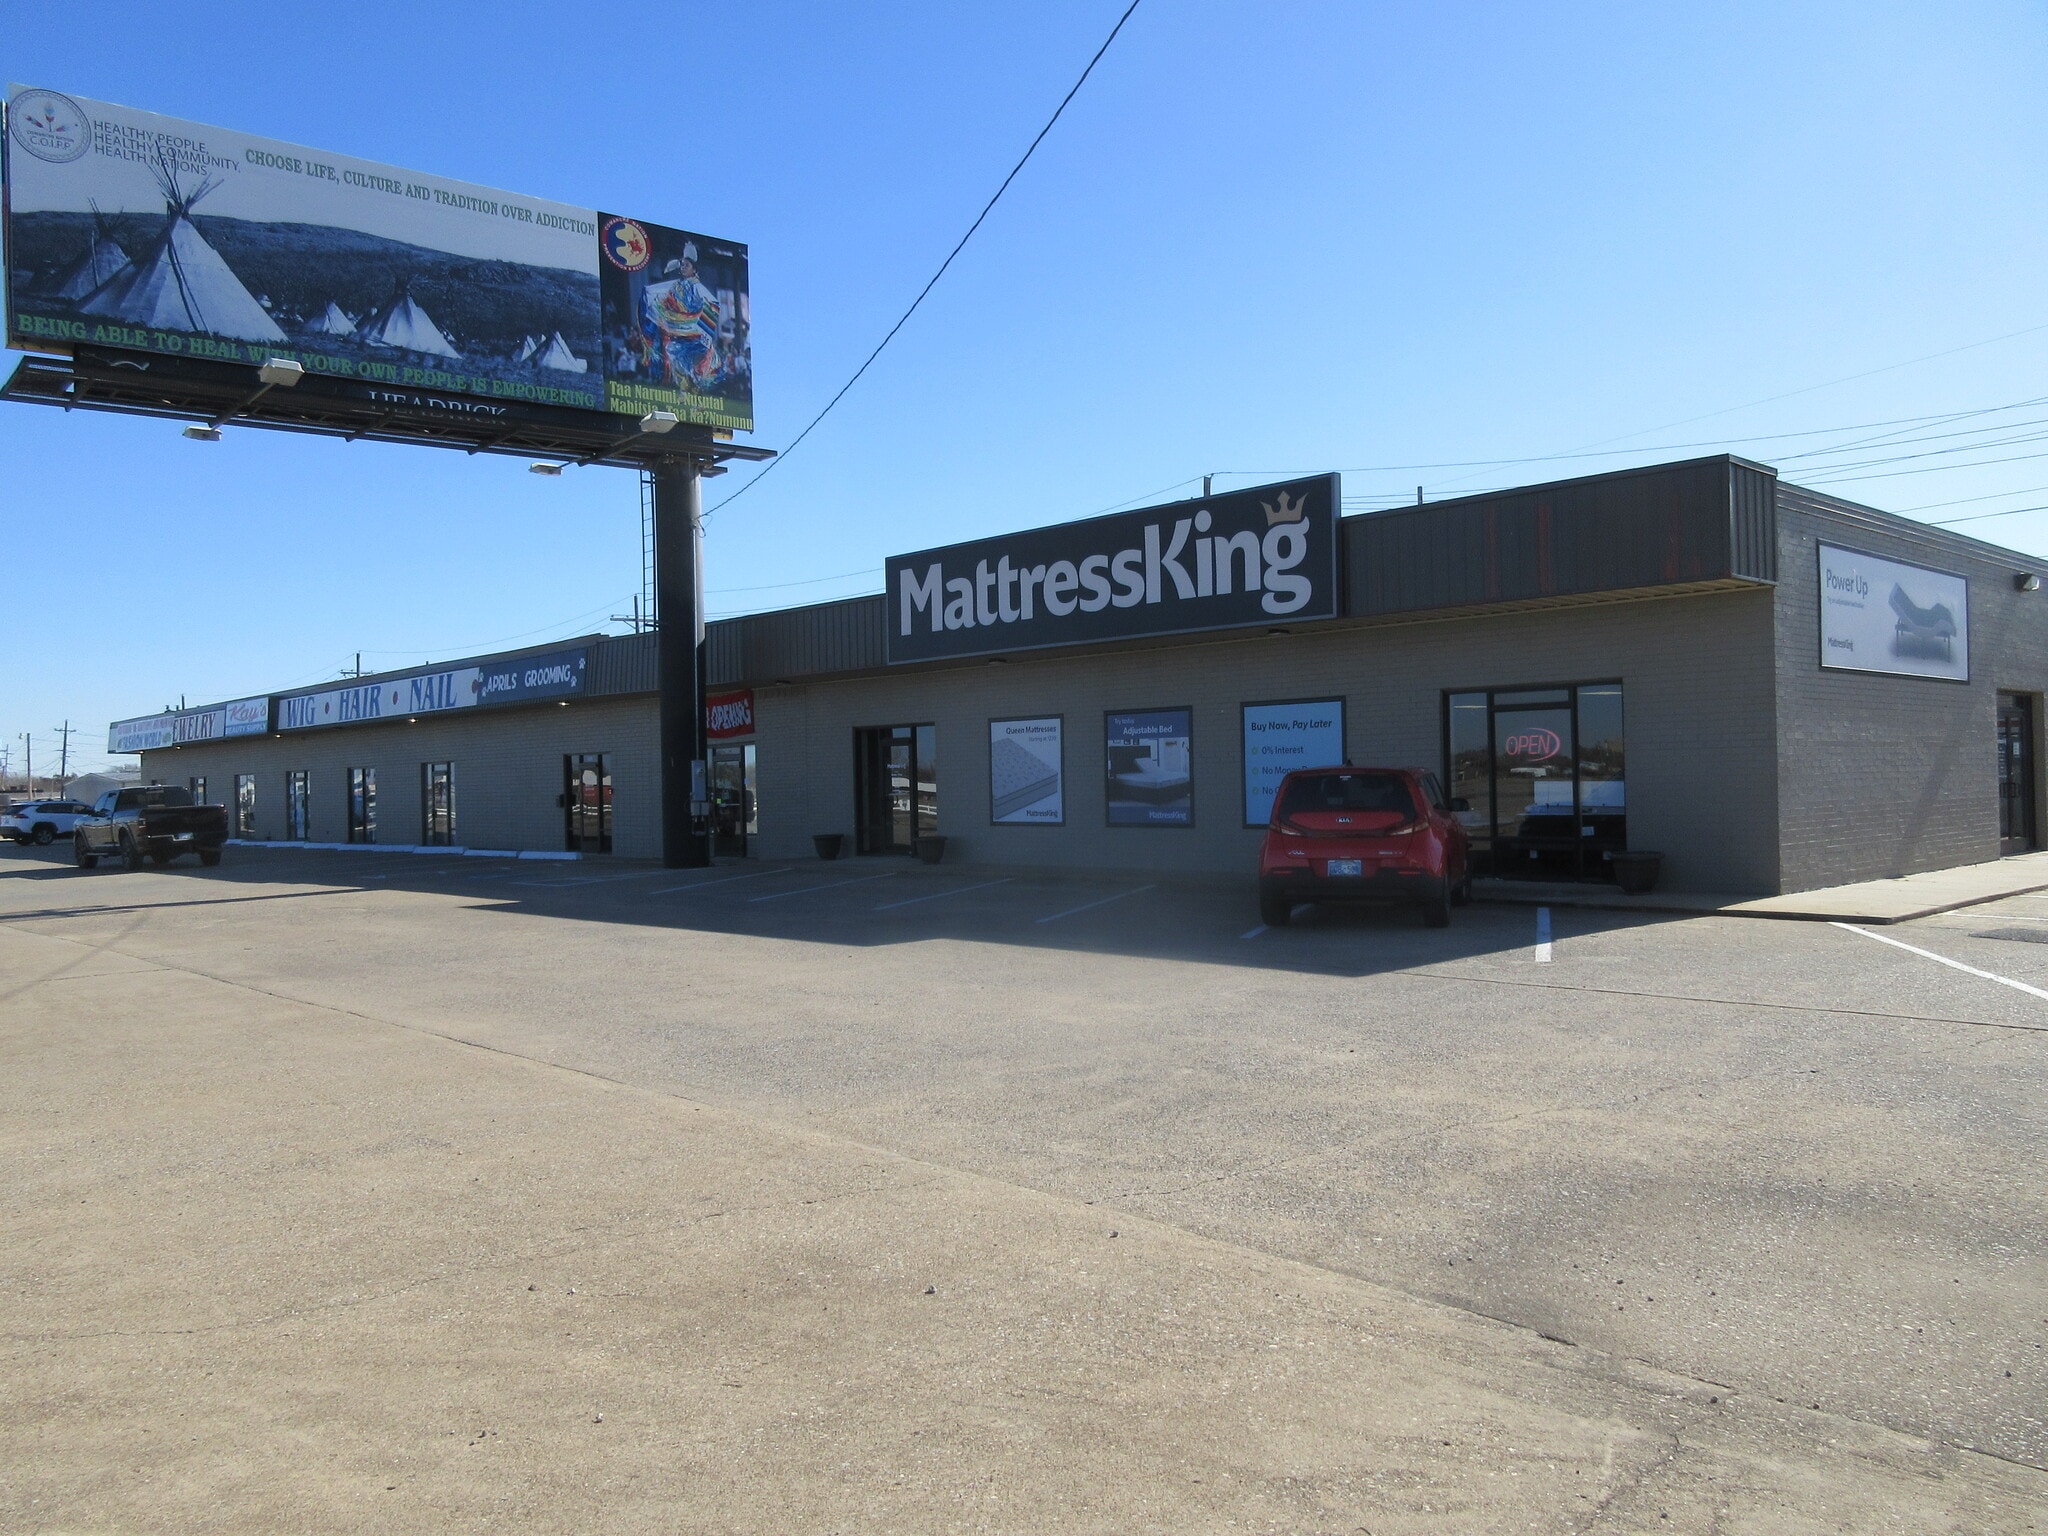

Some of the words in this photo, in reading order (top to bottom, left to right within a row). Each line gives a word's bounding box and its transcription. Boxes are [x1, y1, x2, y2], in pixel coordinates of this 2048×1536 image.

[94, 120, 153, 142] HEALTHY
[158, 133, 209, 154] PEOPLE,
[94, 132, 154, 153] HEALTHY
[159, 145, 241, 173] COMMUNITY,
[95, 143, 147, 163] HEALTH
[150, 155, 208, 176] NATIONS
[245, 148, 303, 174] CHOOSE
[306, 161, 340, 185] LIFE,
[343, 170, 402, 195] CULTURE
[405, 183, 431, 201] AND
[434, 189, 499, 216] TRADITION
[501, 204, 533, 224] OVER
[536, 212, 596, 237] ADDICTION
[17, 314, 88, 340] BEING
[93, 324, 149, 348] ABLE
[153, 332, 183, 350] TO
[189, 337, 242, 360] HEAL
[302, 354, 353, 376] YOUR
[357, 361, 397, 379] OWN
[403, 367, 467, 390] PEOPLE
[470, 377, 488, 392] IS
[492, 380, 596, 408] EMPOWERING
[609, 380, 631, 397] Taa
[667, 405, 687, 421] Taa
[900, 509, 1312, 637] MattressKing
[1826, 568, 1855, 593] Power
[1855, 577, 1869, 600] Up
[485, 672, 518, 692] APRILS
[524, 664, 571, 688] GROOMING
[286, 696, 316, 728] WIG
[338, 684, 382, 722] HAIR
[409, 673, 458, 713] NAIL
[711, 698, 752, 731] OPENING
[172, 713, 216, 742] EWELRY
[1006, 727, 1025, 735] Queen
[1025, 725, 1057, 733] Mattresses
[1123, 726, 1158, 736] Adjustable
[1158, 725, 1173, 734] Bed
[1251, 722, 1266, 732] Buy
[1268, 722, 1290, 731] Now,
[1292, 720, 1308, 731] Pay
[1310, 719, 1332, 729] Later
[1261, 746, 1274, 754] 0%
[1275, 746, 1304, 754] Interest
[1505, 734, 1550, 756] OPEN
[1262, 766, 1273, 774] No
[1262, 787, 1273, 795] No
